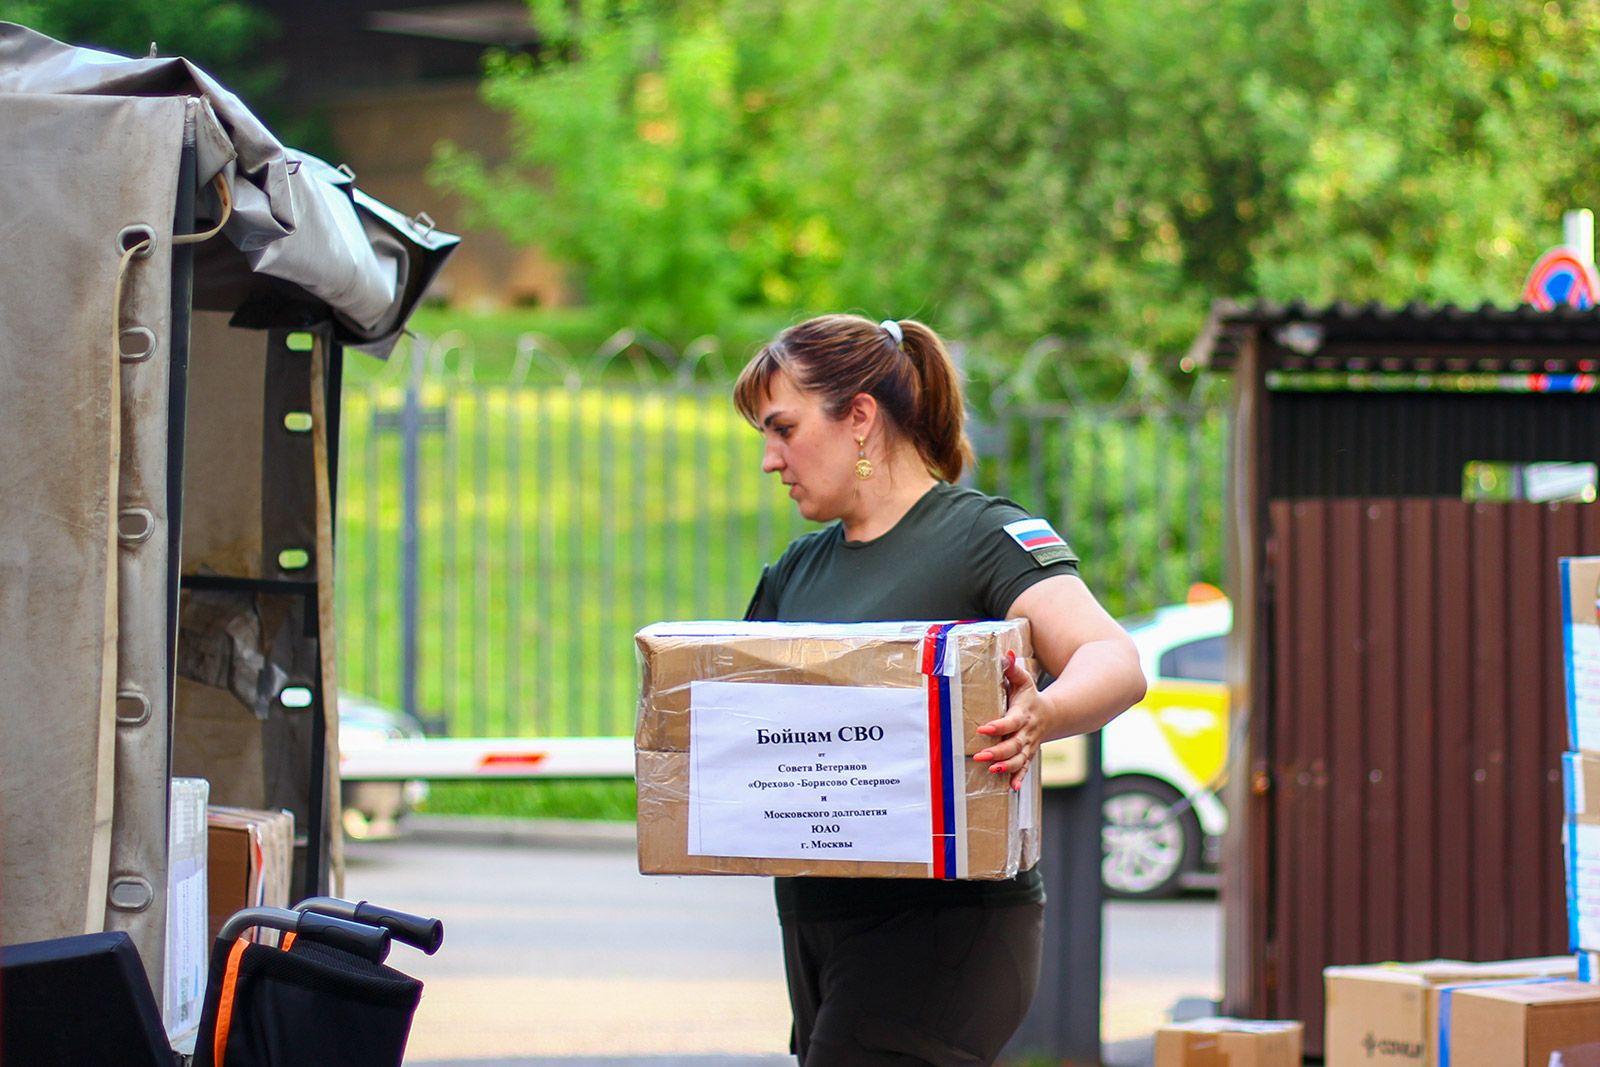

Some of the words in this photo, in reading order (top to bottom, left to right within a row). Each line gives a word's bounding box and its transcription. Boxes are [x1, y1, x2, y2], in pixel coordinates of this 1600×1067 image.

[756, 728, 832, 745] Бойцам
[838, 725, 884, 742] СВО
[778, 763, 813, 773] Совета
[816, 762, 867, 773] Ветеранов
[850, 777, 901, 788] Северное»
[764, 810, 830, 820] Московского
[831, 808, 887, 818] долголетия
[811, 824, 840, 833] ЮАО
[811, 840, 853, 849] Москвы
